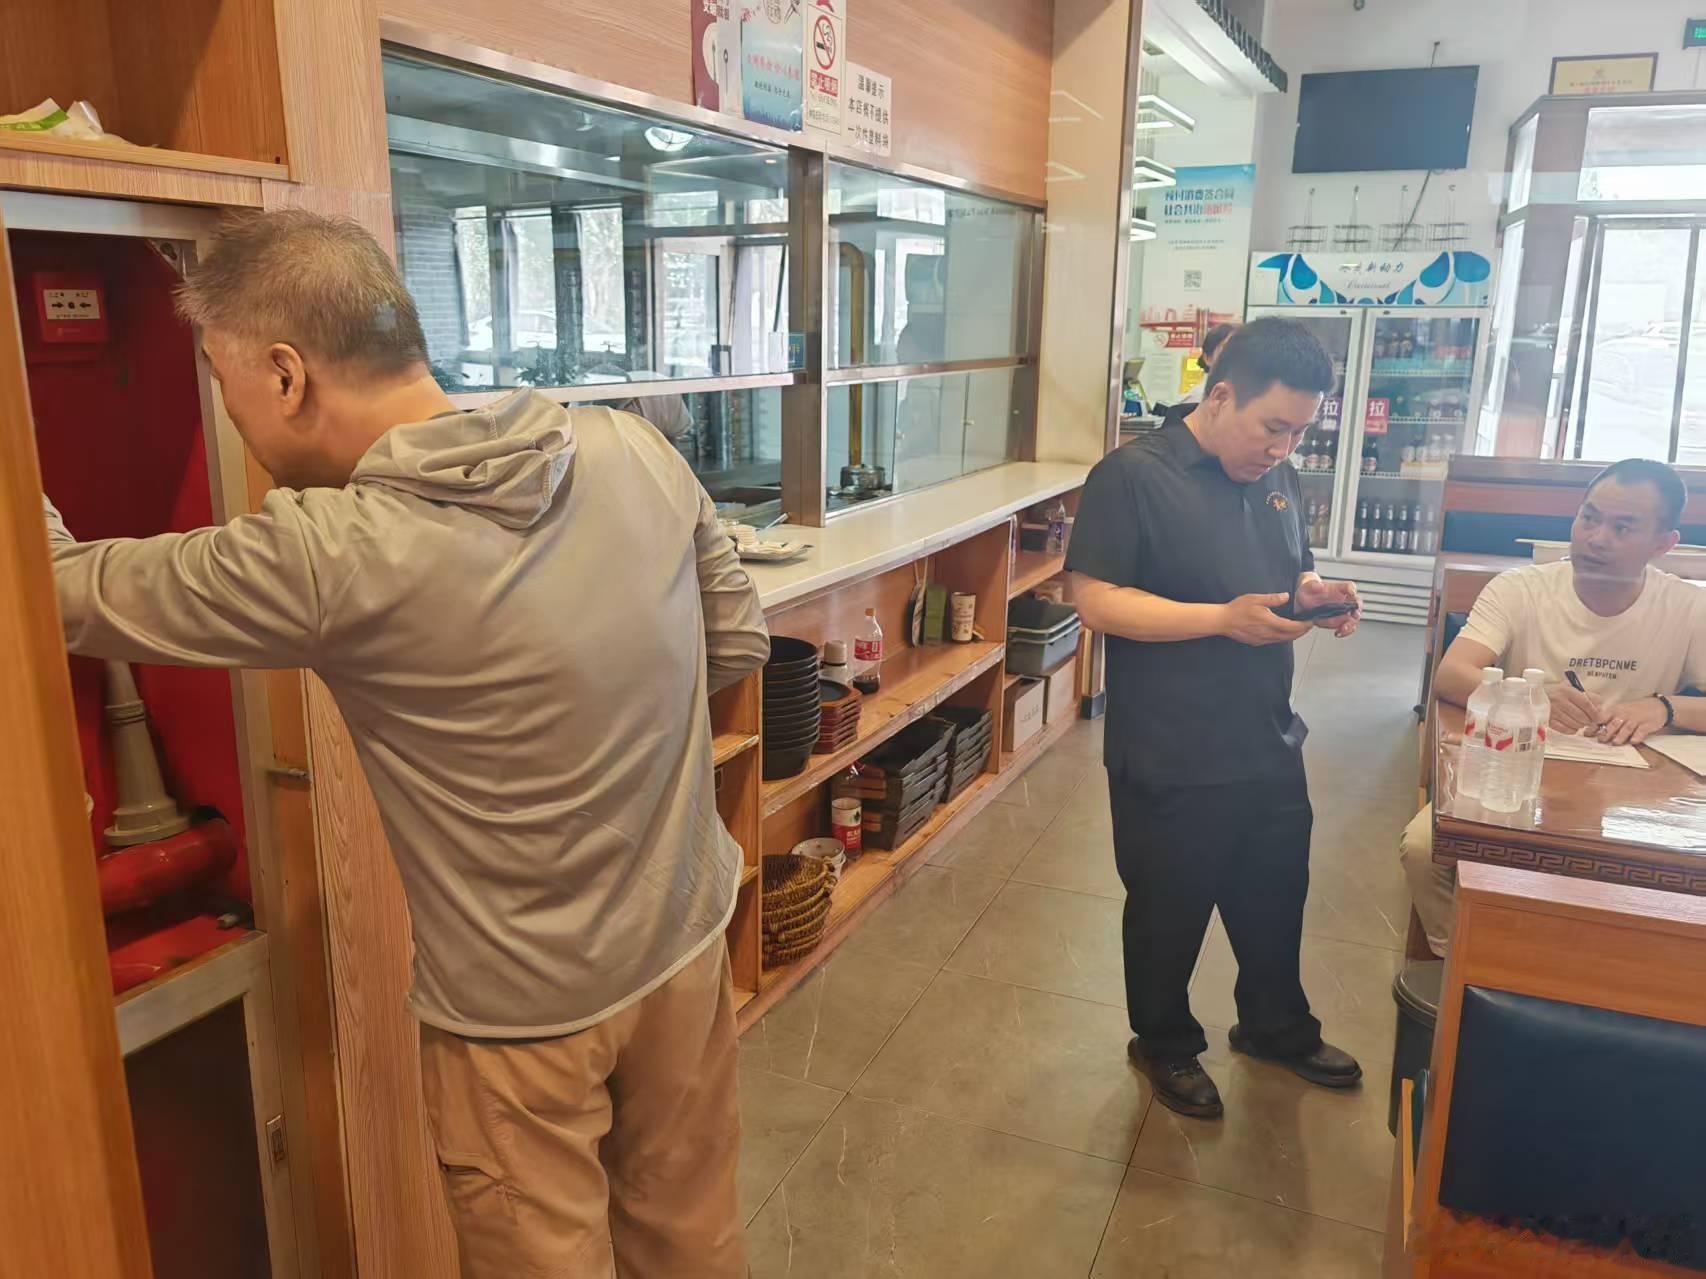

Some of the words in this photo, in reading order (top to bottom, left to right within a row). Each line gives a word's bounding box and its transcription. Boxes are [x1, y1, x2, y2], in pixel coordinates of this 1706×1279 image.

[1323, 401, 1339, 417] 拉
[1369, 401, 1385, 417] 拉
[1568, 657, 1638, 672] DRETBPCNME
